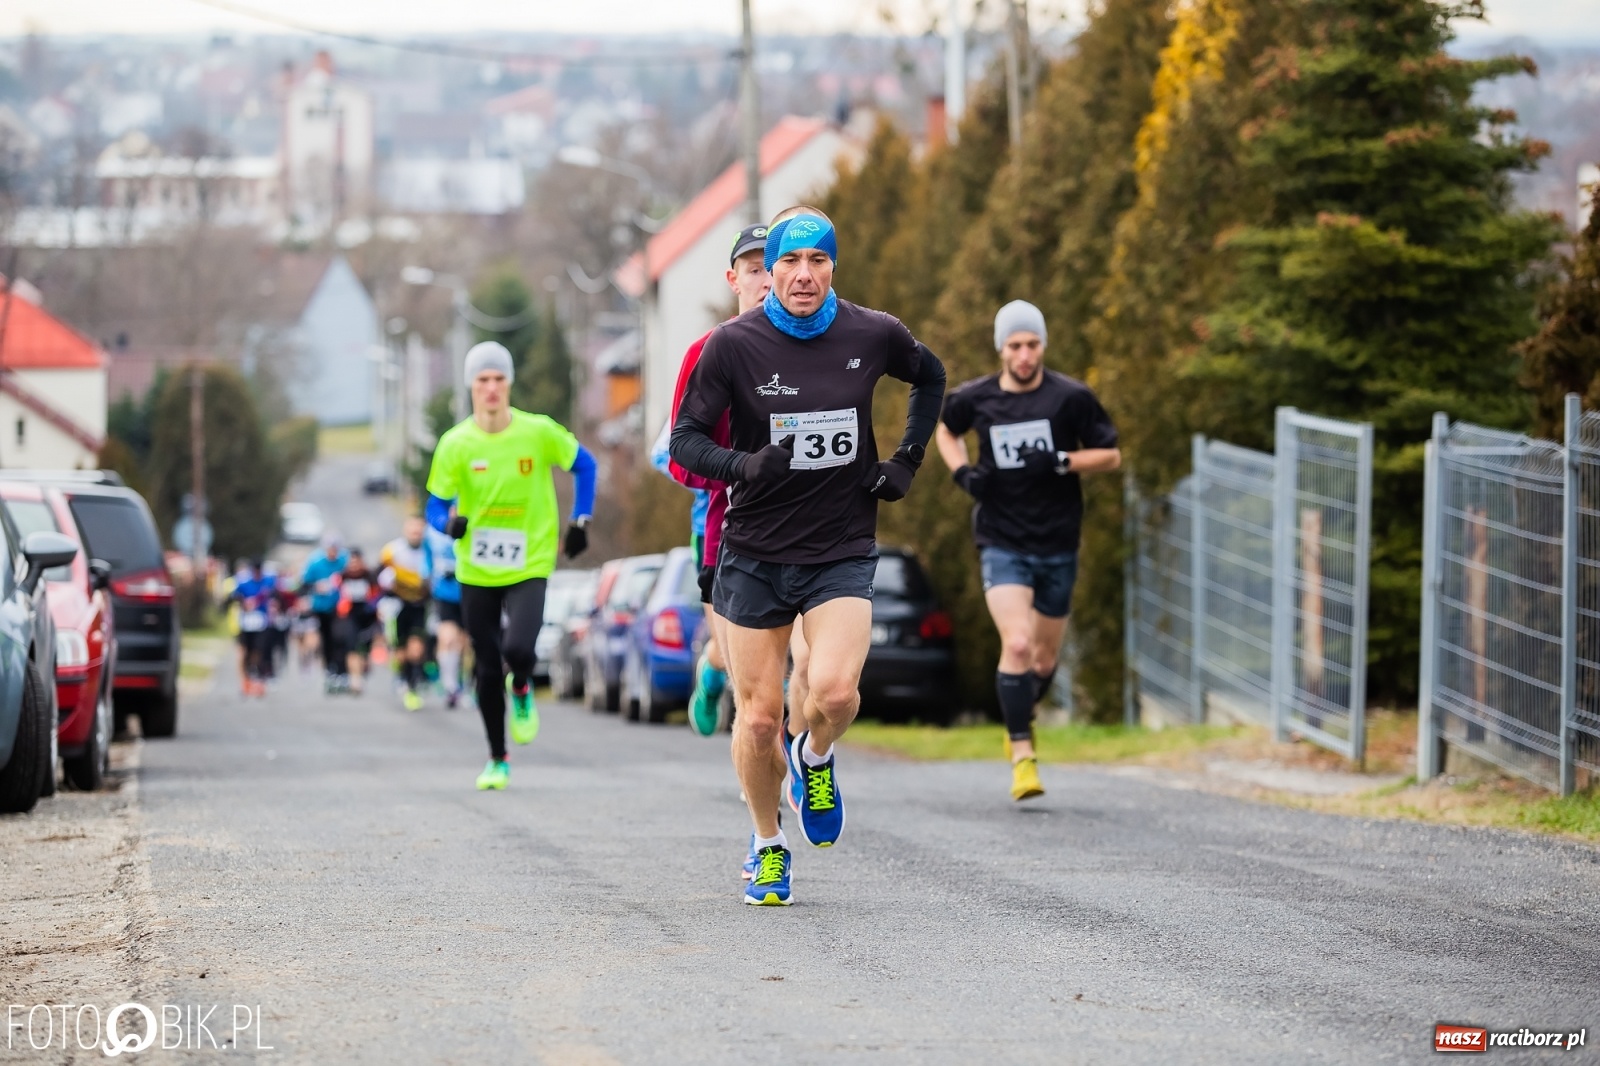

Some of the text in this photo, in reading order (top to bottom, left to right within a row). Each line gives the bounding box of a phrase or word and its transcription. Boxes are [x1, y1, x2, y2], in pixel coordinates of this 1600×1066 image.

[781, 388, 798, 396] Team
[802, 415, 855, 425] www.personalbest.pl
[1001, 437, 1047, 462] 10
[476, 540, 521, 562] 247
